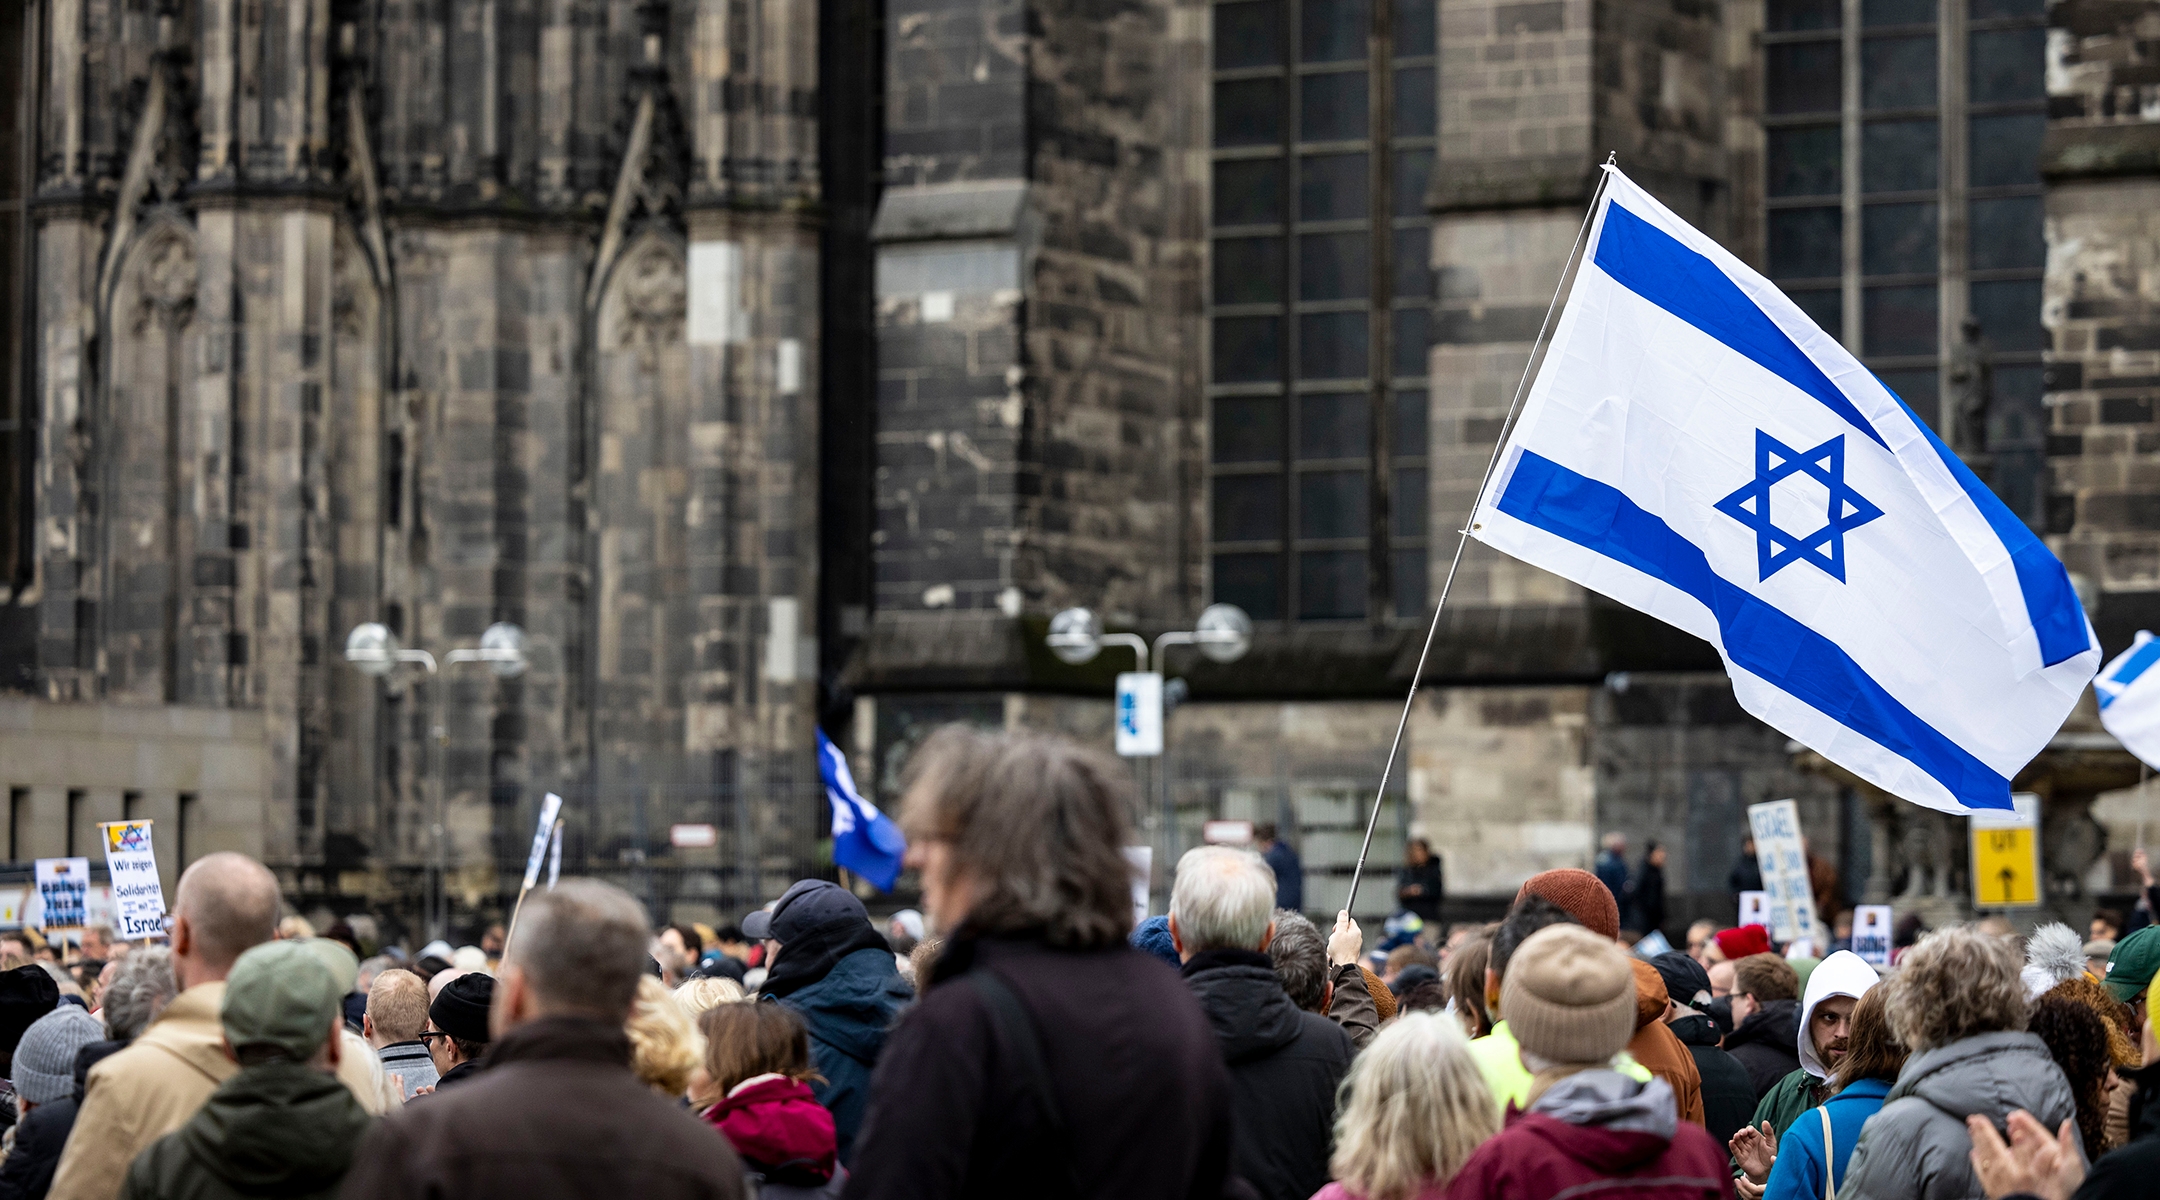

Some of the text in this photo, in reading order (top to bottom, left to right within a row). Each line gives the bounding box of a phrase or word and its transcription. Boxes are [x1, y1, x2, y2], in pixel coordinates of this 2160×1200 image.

[114, 858, 153, 873] Wir zeigen
[41, 879, 86, 893] BRING
[116, 884, 160, 898] Solidarität
[45, 898, 84, 910] THEM
[43, 913, 84, 928] HOME
